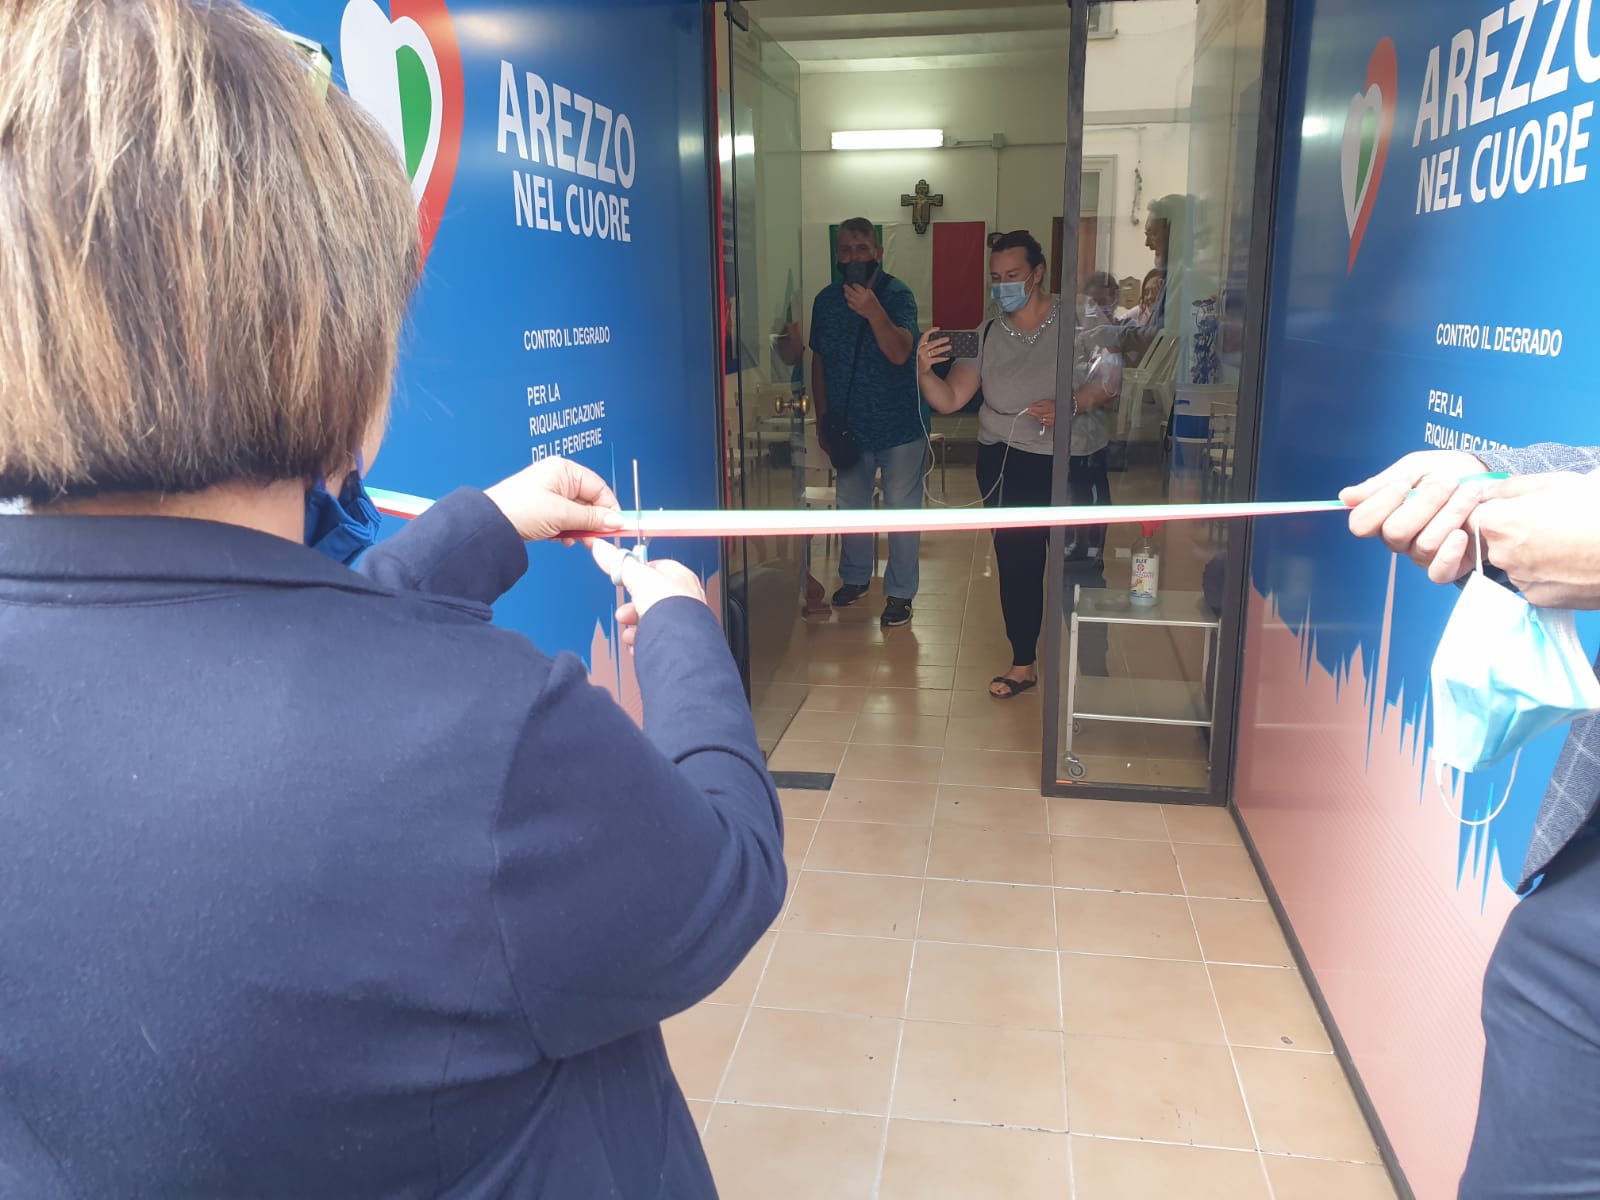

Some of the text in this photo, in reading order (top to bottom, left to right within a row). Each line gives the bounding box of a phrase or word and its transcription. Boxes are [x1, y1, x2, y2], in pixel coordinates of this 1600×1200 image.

[497, 59, 635, 189] AREZZO
[1416, 100, 1595, 215] NEL CUORE
[512, 170, 631, 242] NEL CUORE
[523, 326, 610, 350] CONTRO IL DEGRADO
[1436, 323, 1563, 357] CONTRO IL DEGRADO
[527, 383, 560, 406] PER LA
[1428, 389, 1463, 419] PER LA
[529, 401, 606, 437] RIQUALIFICAZIONE
[562, 427, 603, 456] PERIFERIE
